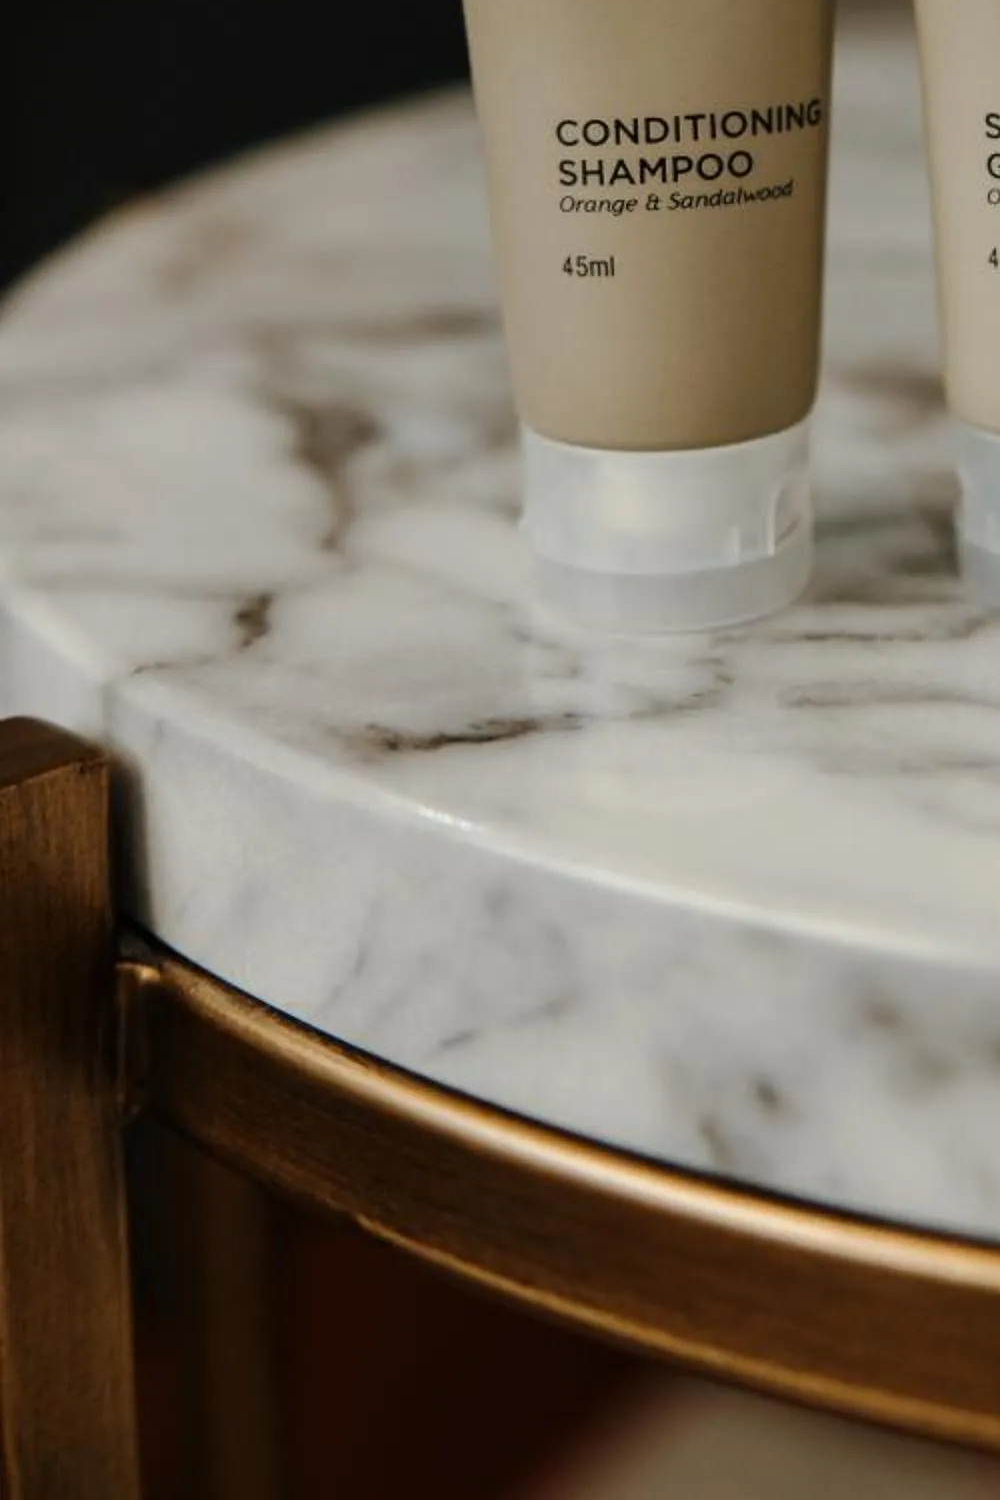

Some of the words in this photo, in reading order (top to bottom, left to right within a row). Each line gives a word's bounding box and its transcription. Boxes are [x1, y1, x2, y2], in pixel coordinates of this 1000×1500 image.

[556, 98, 822, 146] CONDITIONING
[559, 151, 753, 186] SHAMPOO
[559, 194, 637, 216] Orange
[645, 192, 660, 211] &
[668, 180, 795, 210] Sandalwood
[562, 256, 615, 277] 45ml
